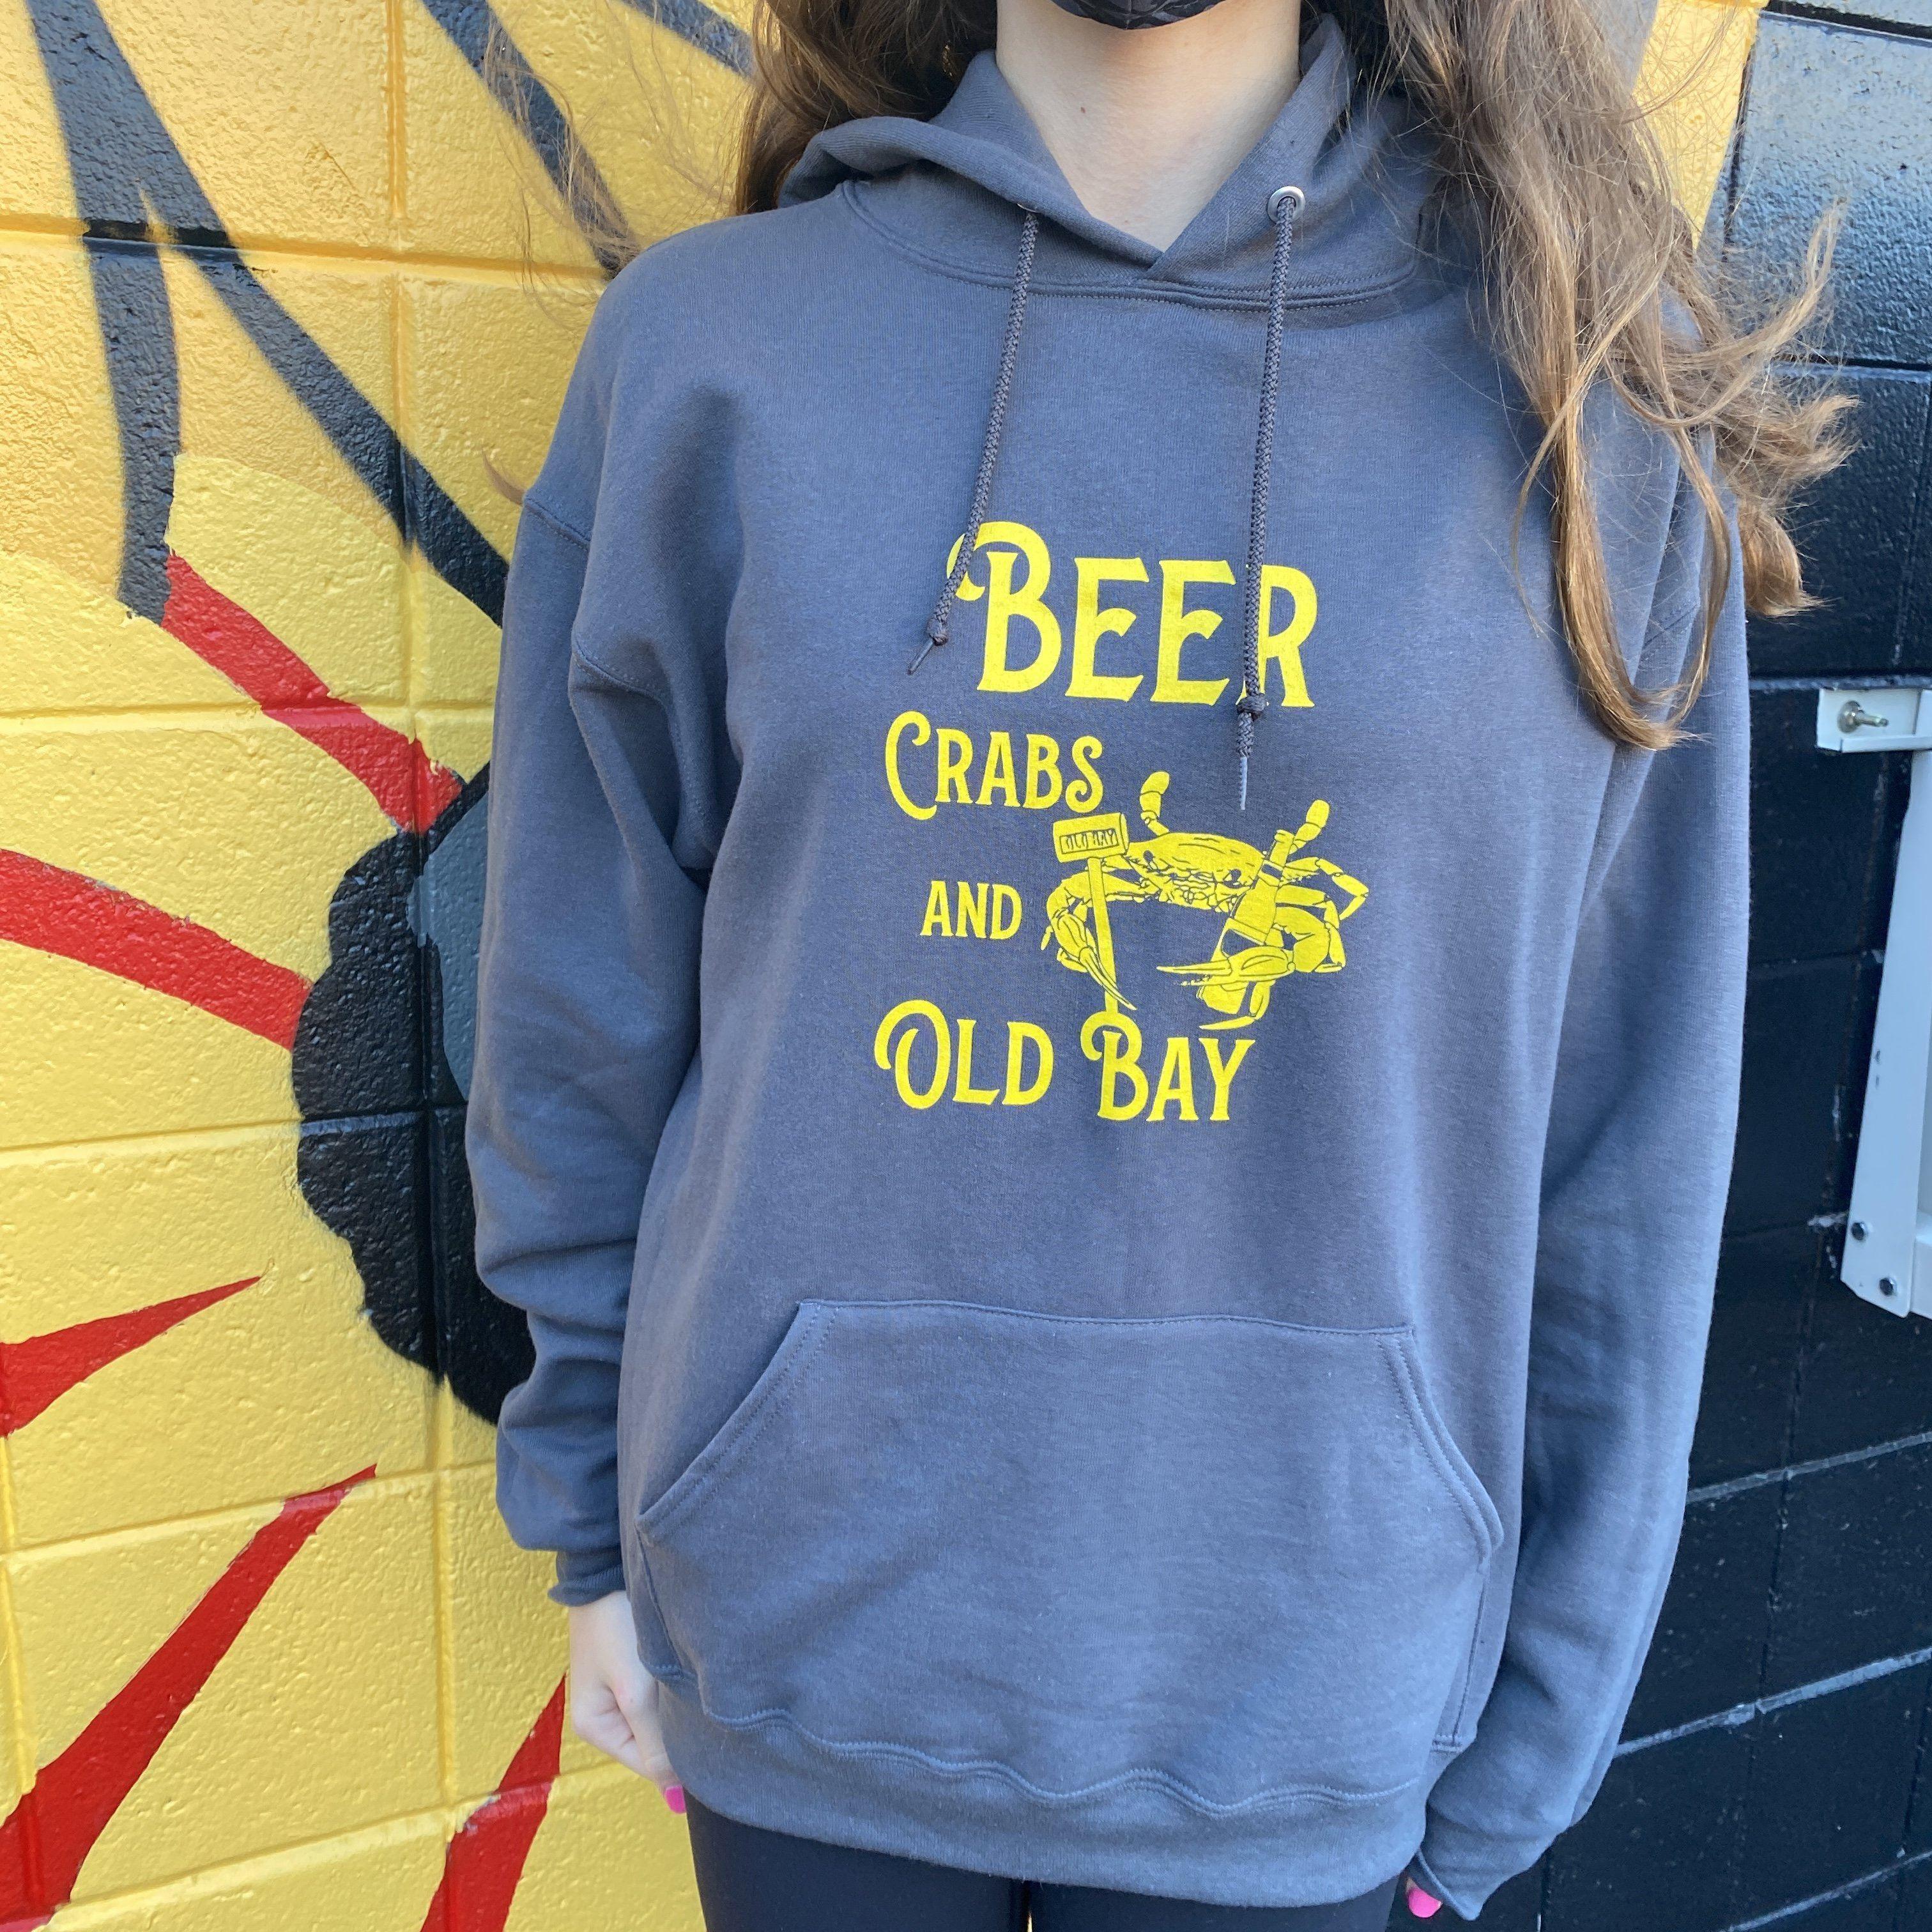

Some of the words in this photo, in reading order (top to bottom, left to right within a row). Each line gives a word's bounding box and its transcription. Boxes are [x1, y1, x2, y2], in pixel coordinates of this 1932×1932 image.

[947, 521, 1318, 708] BEER
[885, 710, 1104, 820] CRABS
[919, 880, 1023, 940] AND
[874, 999, 1055, 1110] OLD
[1080, 1010, 1256, 1122] BAY
